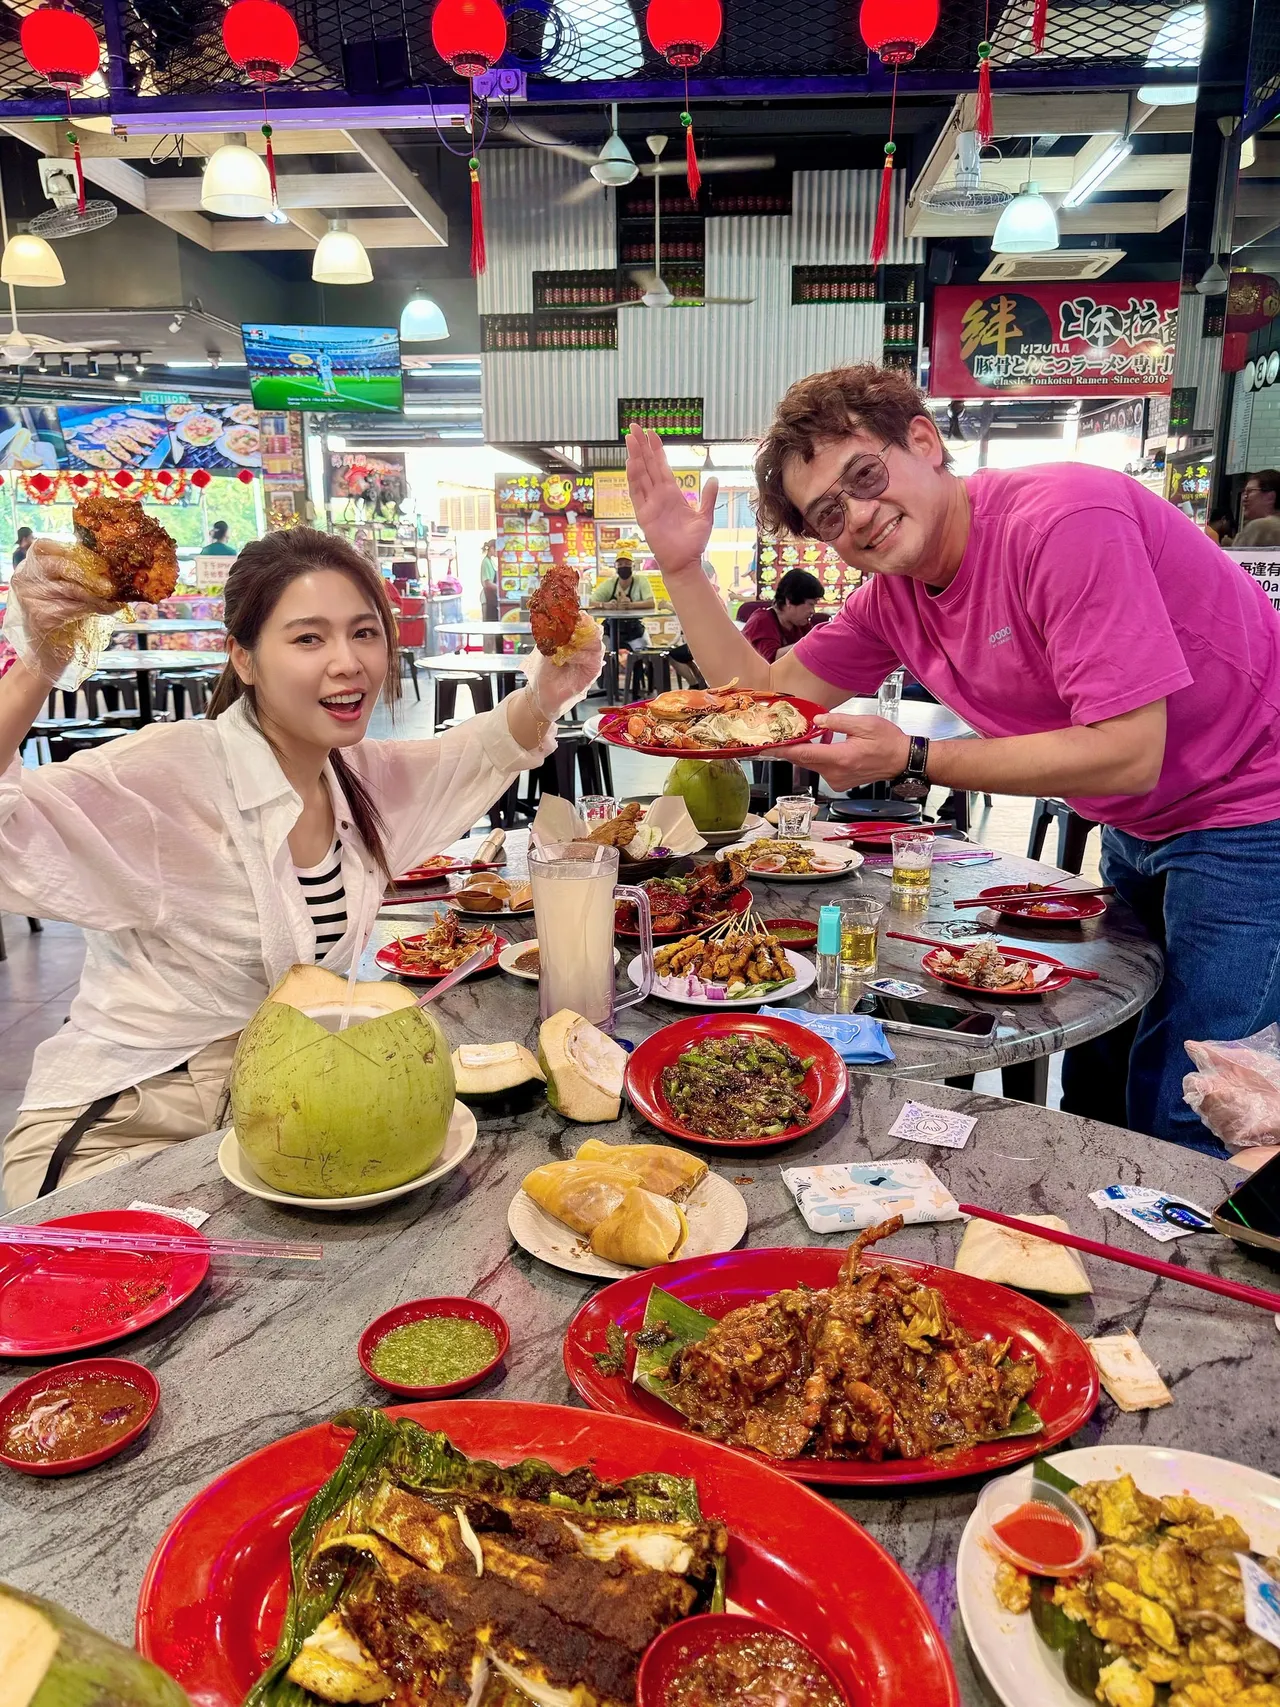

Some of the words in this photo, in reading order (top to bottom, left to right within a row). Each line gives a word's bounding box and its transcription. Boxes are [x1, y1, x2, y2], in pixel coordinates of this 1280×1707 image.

[960, 295, 1023, 360] 絆
[974, 354, 1175, 378] 豚骨とんこつラーメン専門
[993, 376, 1026, 386] Classic
[1028, 376, 1073, 385] Tonkotsu
[1076, 375, 1108, 385] Ramen
